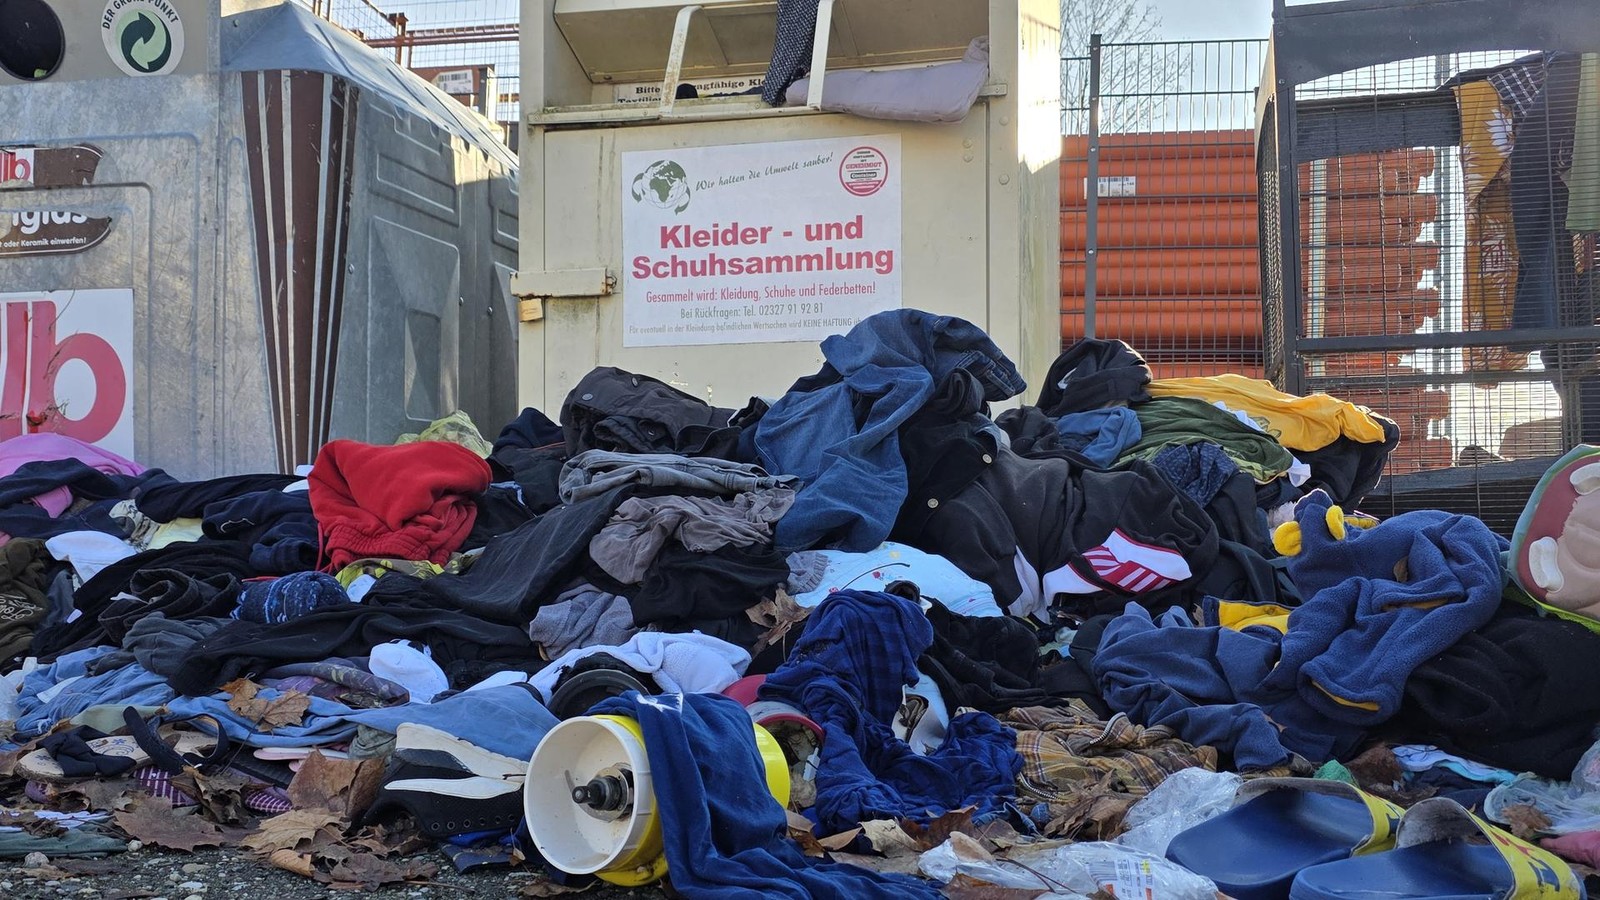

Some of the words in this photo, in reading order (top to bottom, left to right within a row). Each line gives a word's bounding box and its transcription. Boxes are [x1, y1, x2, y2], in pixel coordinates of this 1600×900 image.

[102, 8, 116, 30] DER
[635, 86, 661, 94] Bitte
[696, 179, 715, 191] Wir
[718, 174, 745, 186] halten
[748, 169, 761, 180] die
[764, 161, 799, 176] Umwelt
[802, 151, 834, 168] sauber!
[3, 240, 20, 248] oder
[21, 239, 49, 247] Keramik
[50, 237, 87, 245] einwerfen!
[660, 222, 773, 249] Kleider
[804, 214, 864, 242] und
[631, 246, 895, 280] Schuhsammlung
[646, 288, 694, 303] Gesammelt
[696, 287, 718, 302] wird:
[720, 286, 761, 301] Kleidung,
[764, 284, 796, 299] Schuhe
[798, 283, 816, 297] und
[819, 280, 876, 296] Federbetten!
[680, 308, 692, 319] Bei
[695, 306, 741, 319] Rückfragen:
[743, 304, 756, 316] Tel.
[758, 304, 784, 316] 02327
[787, 304, 797, 314] 91
[800, 303, 812, 314] 92
[813, 302, 824, 313] 81
[803, 318, 821, 327] KEINE
[823, 317, 852, 326] HAFTUNG
[0, 300, 126, 444] lb
